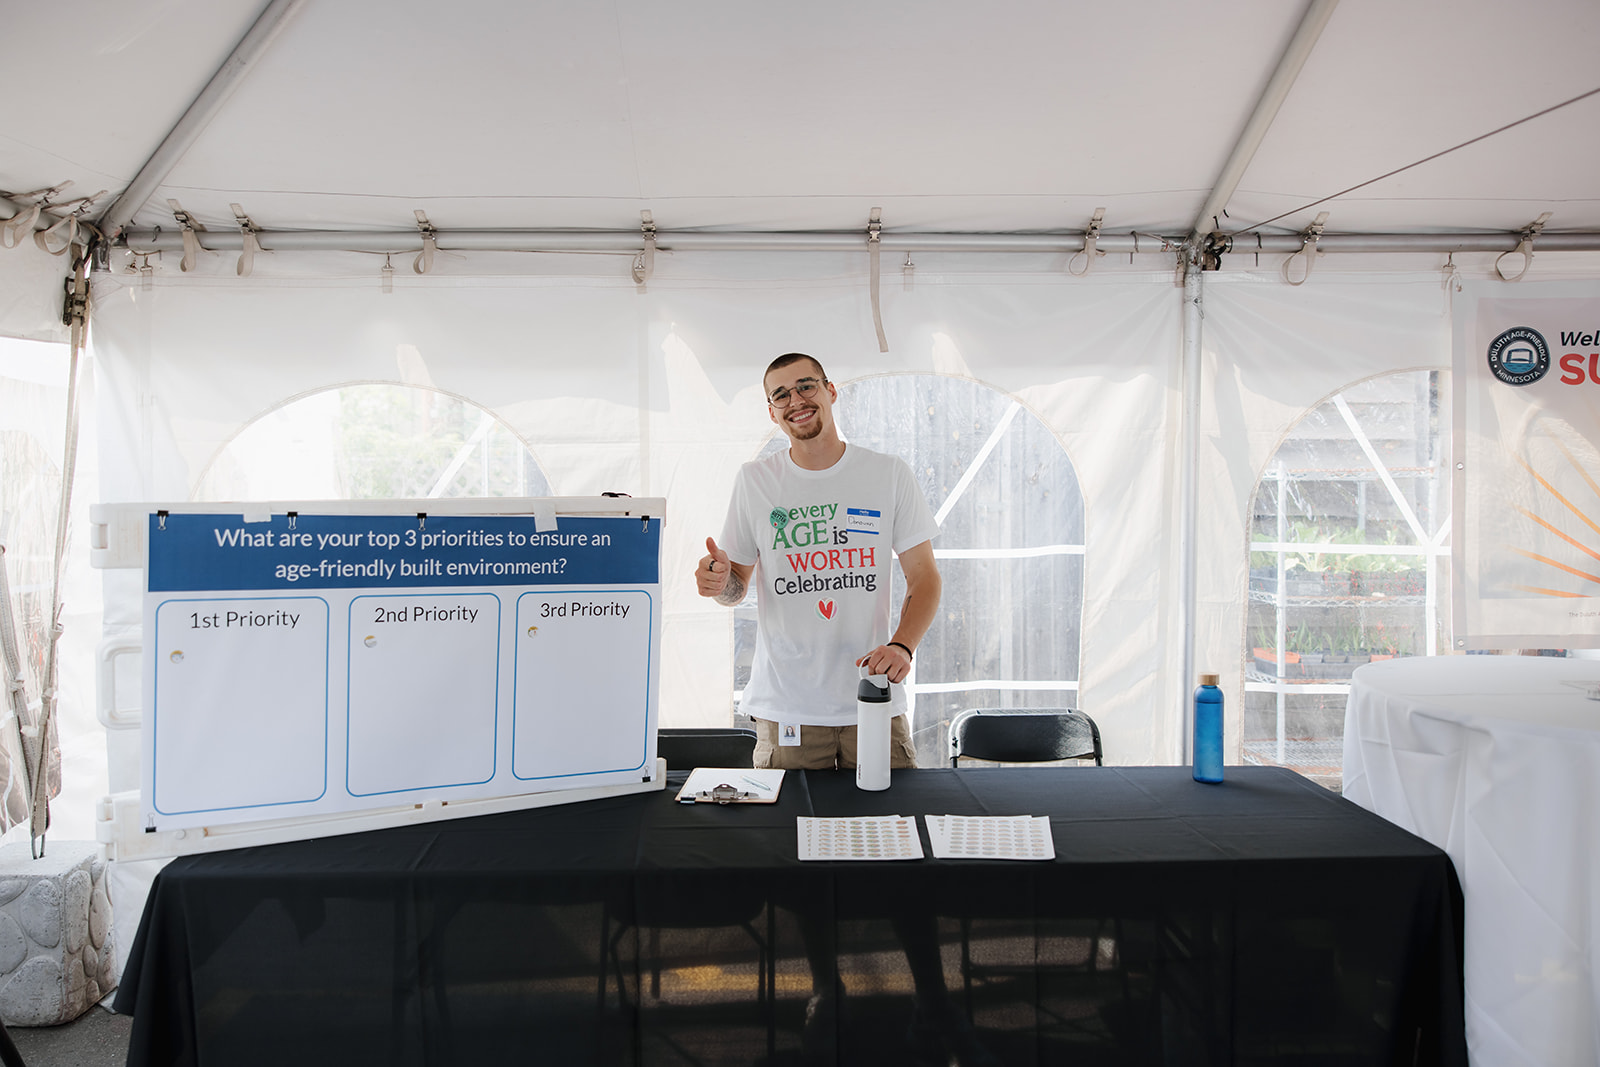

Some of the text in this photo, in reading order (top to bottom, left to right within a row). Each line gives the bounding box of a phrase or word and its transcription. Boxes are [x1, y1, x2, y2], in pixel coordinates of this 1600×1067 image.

[1490, 331, 1547, 362] DULUTH AGE-FRIENDLY
[1560, 330, 1600, 346] Wel
[1496, 369, 1541, 383] MINNESOTA
[788, 503, 839, 520] every
[214, 528, 611, 550] What are your top 3 priorities to ensure an
[772, 520, 829, 550] AGE
[833, 526, 848, 545] is
[275, 558, 567, 581] age-friendly built environment?
[786, 547, 876, 573] WORTH
[774, 572, 877, 595] Celebrating
[190, 610, 300, 629] 1st Priority
[374, 605, 478, 623] 2nd Priority
[540, 602, 630, 618] 3rd Priority
